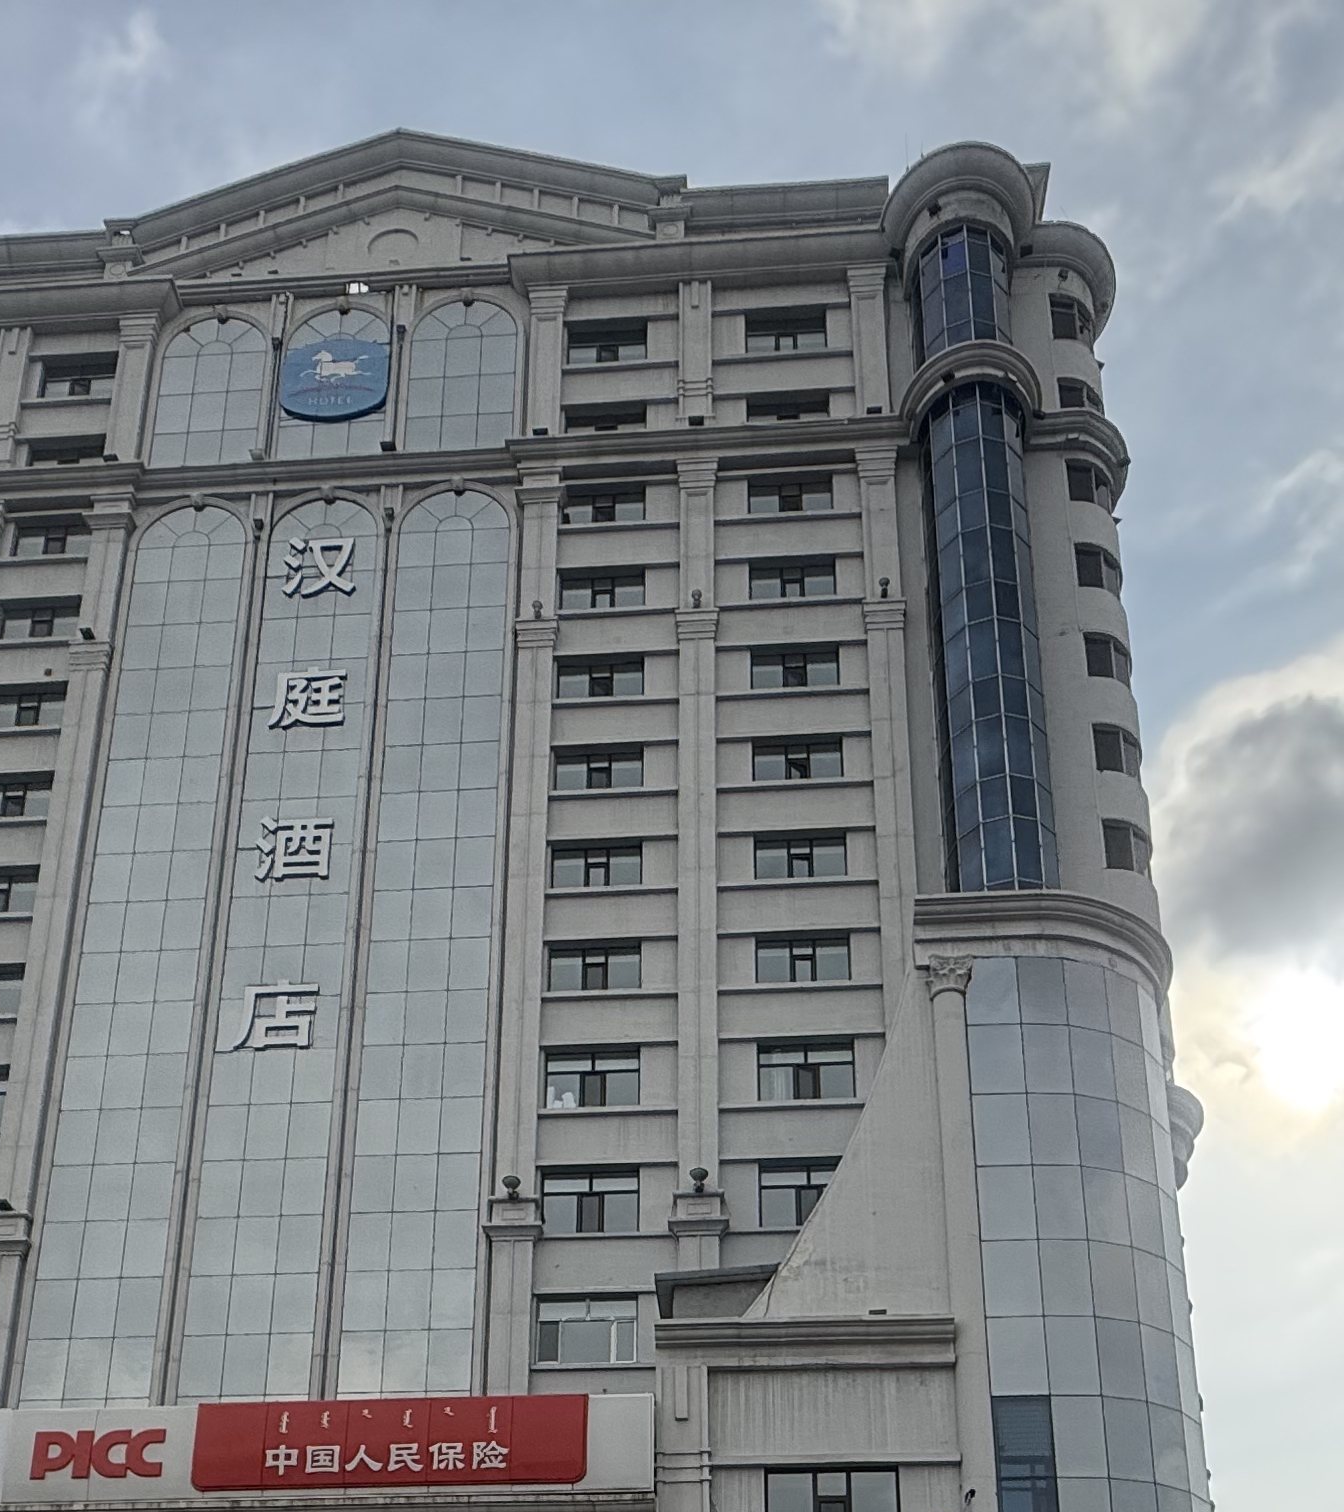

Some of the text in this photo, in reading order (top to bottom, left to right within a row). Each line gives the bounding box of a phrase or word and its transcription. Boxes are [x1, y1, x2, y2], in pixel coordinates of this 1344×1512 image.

[234, 537, 356, 1052] 汉庭酒店
[29, 1428, 167, 1481] PICC
[264, 1439, 509, 1476] 中国人民保险
